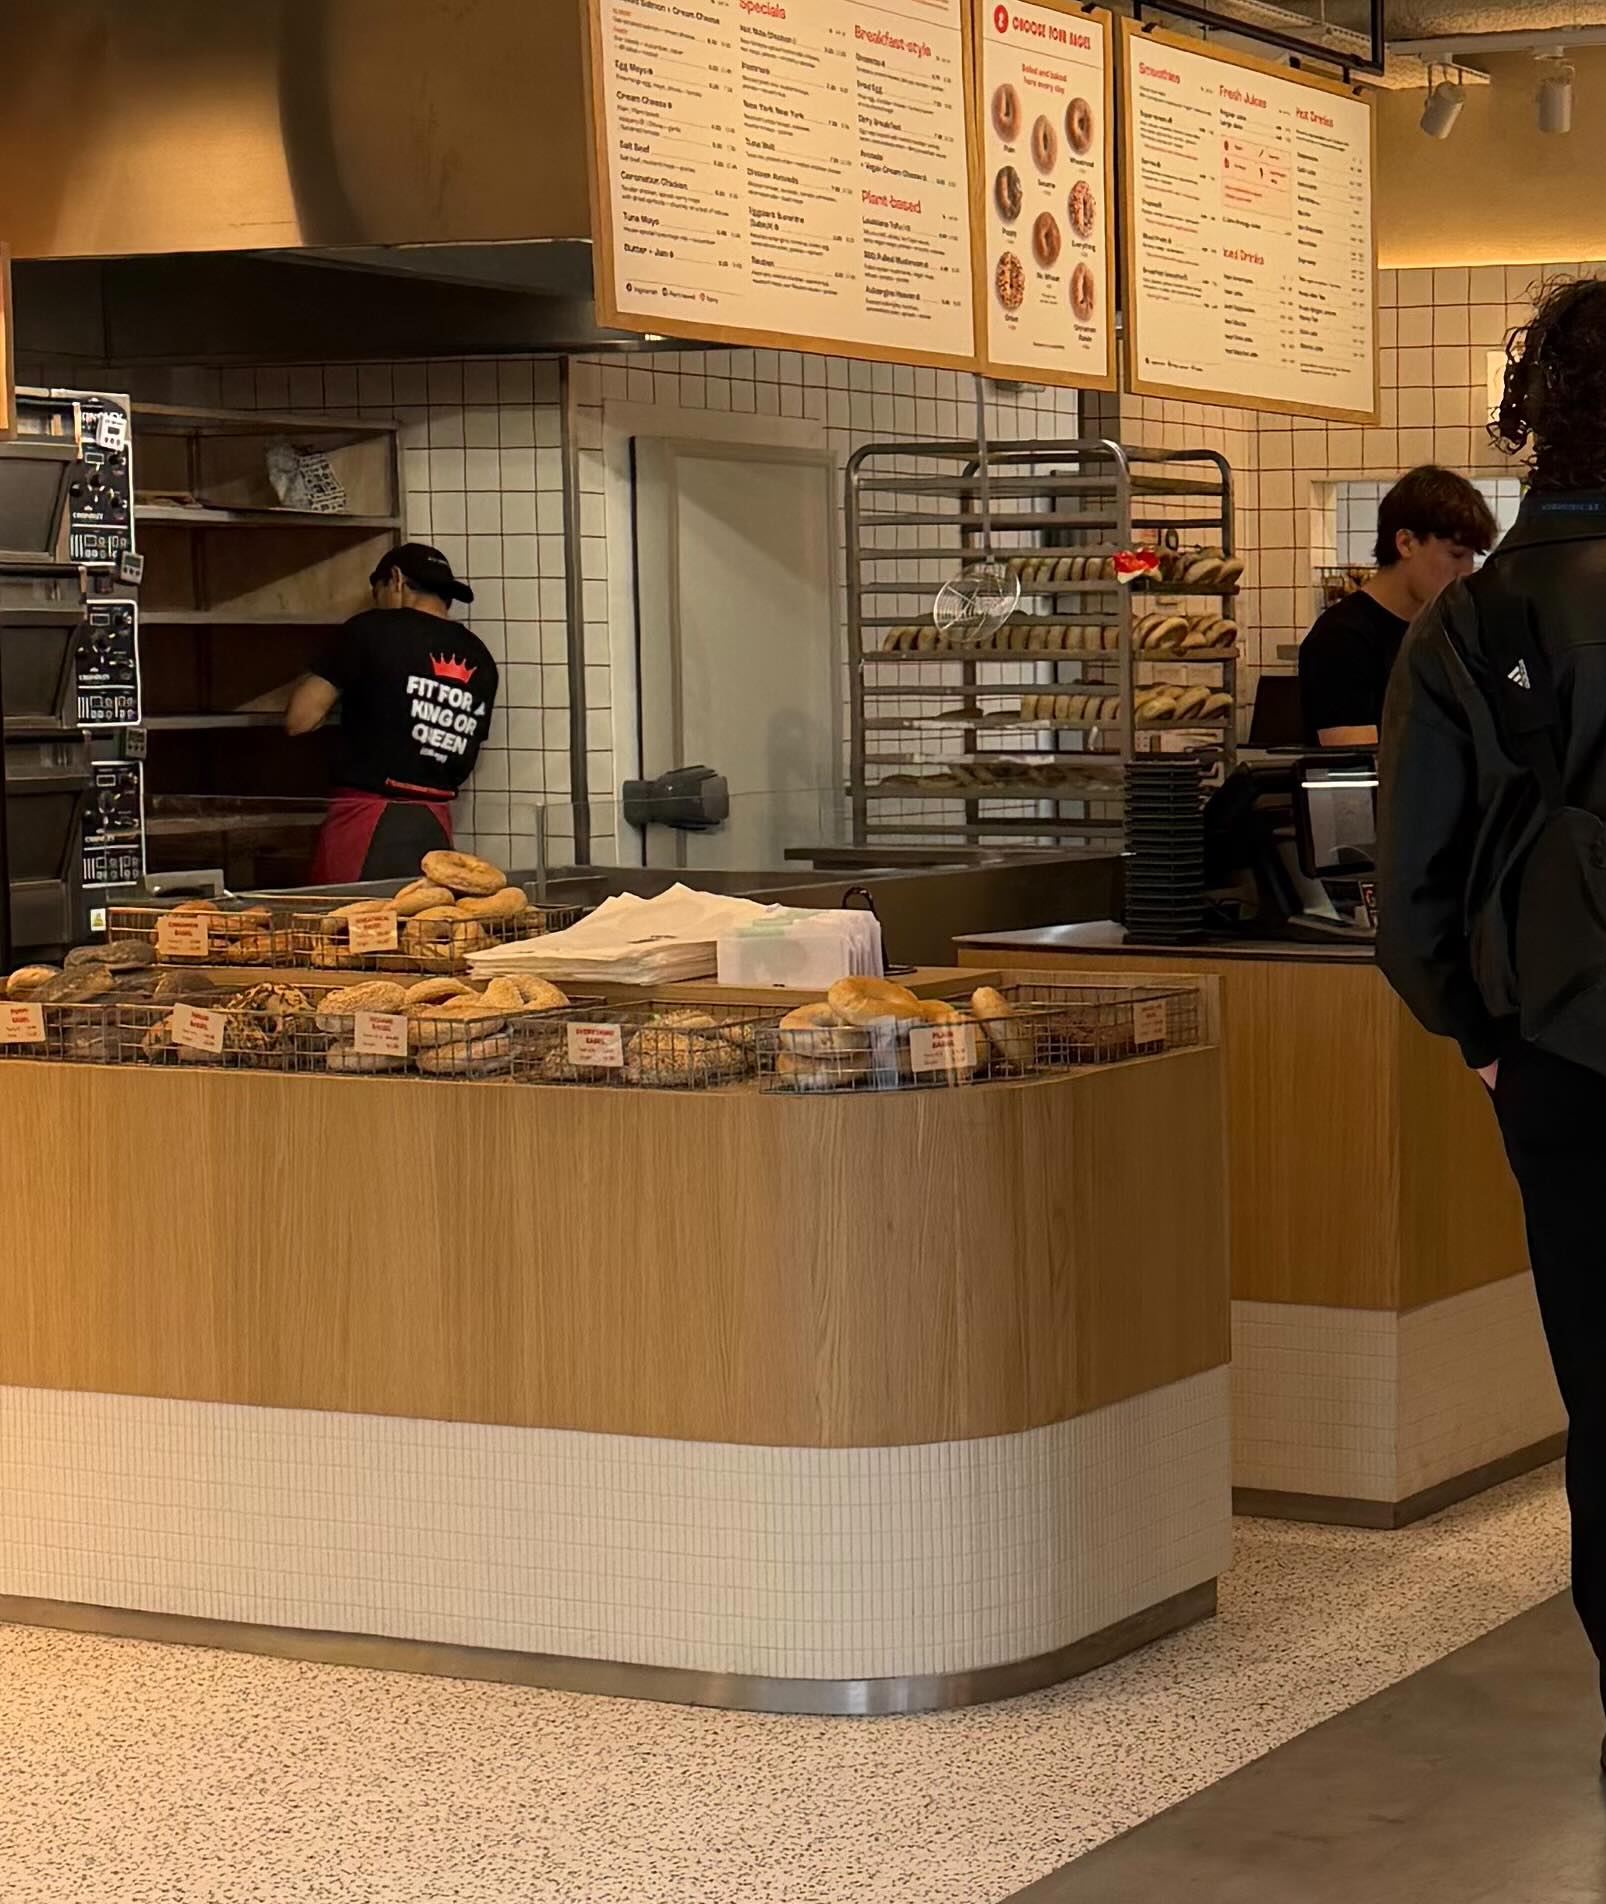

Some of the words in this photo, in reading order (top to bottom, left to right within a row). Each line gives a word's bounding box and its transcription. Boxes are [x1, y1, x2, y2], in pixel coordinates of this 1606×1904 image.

[1012, 16, 1046, 38] CHOOSE
[1048, 26, 1067, 44] YOUR
[1069, 32, 1091, 50] BAGEL
[1219, 84, 1242, 103] Fresh
[1244, 91, 1267, 109] Juices
[1309, 110, 1334, 128] Drinks
[1240, 249, 1265, 265] Drinks
[406, 675, 439, 699] FIT
[437, 683, 473, 712] FOR
[411, 698, 454, 728] KING
[453, 713, 478, 736] OR
